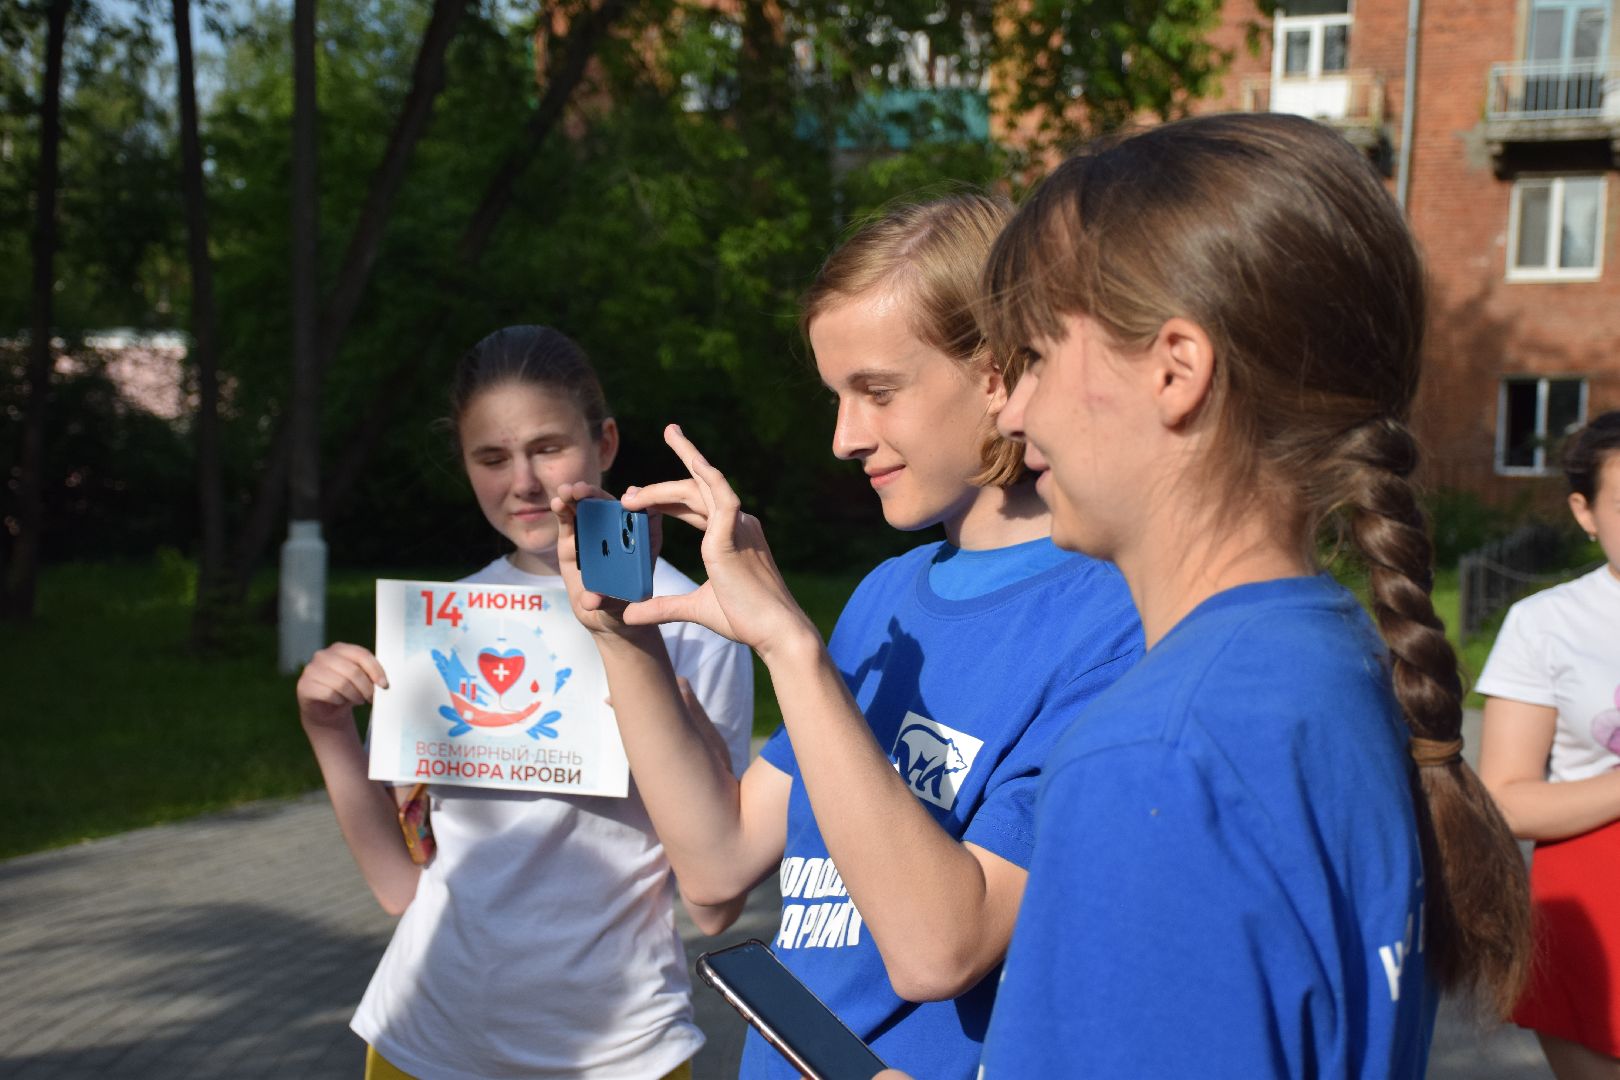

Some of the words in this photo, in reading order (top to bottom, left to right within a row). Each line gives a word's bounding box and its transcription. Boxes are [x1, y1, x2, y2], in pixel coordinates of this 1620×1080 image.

[421, 590, 463, 627] 14
[467, 591, 543, 611] ИЮНЯ
[416, 741, 529, 762] ВСЕМИРНЫЙ
[534, 748, 583, 766] ДЕНЬ
[415, 759, 504, 780] ДОНОРА
[510, 765, 581, 785] КРОВИ
